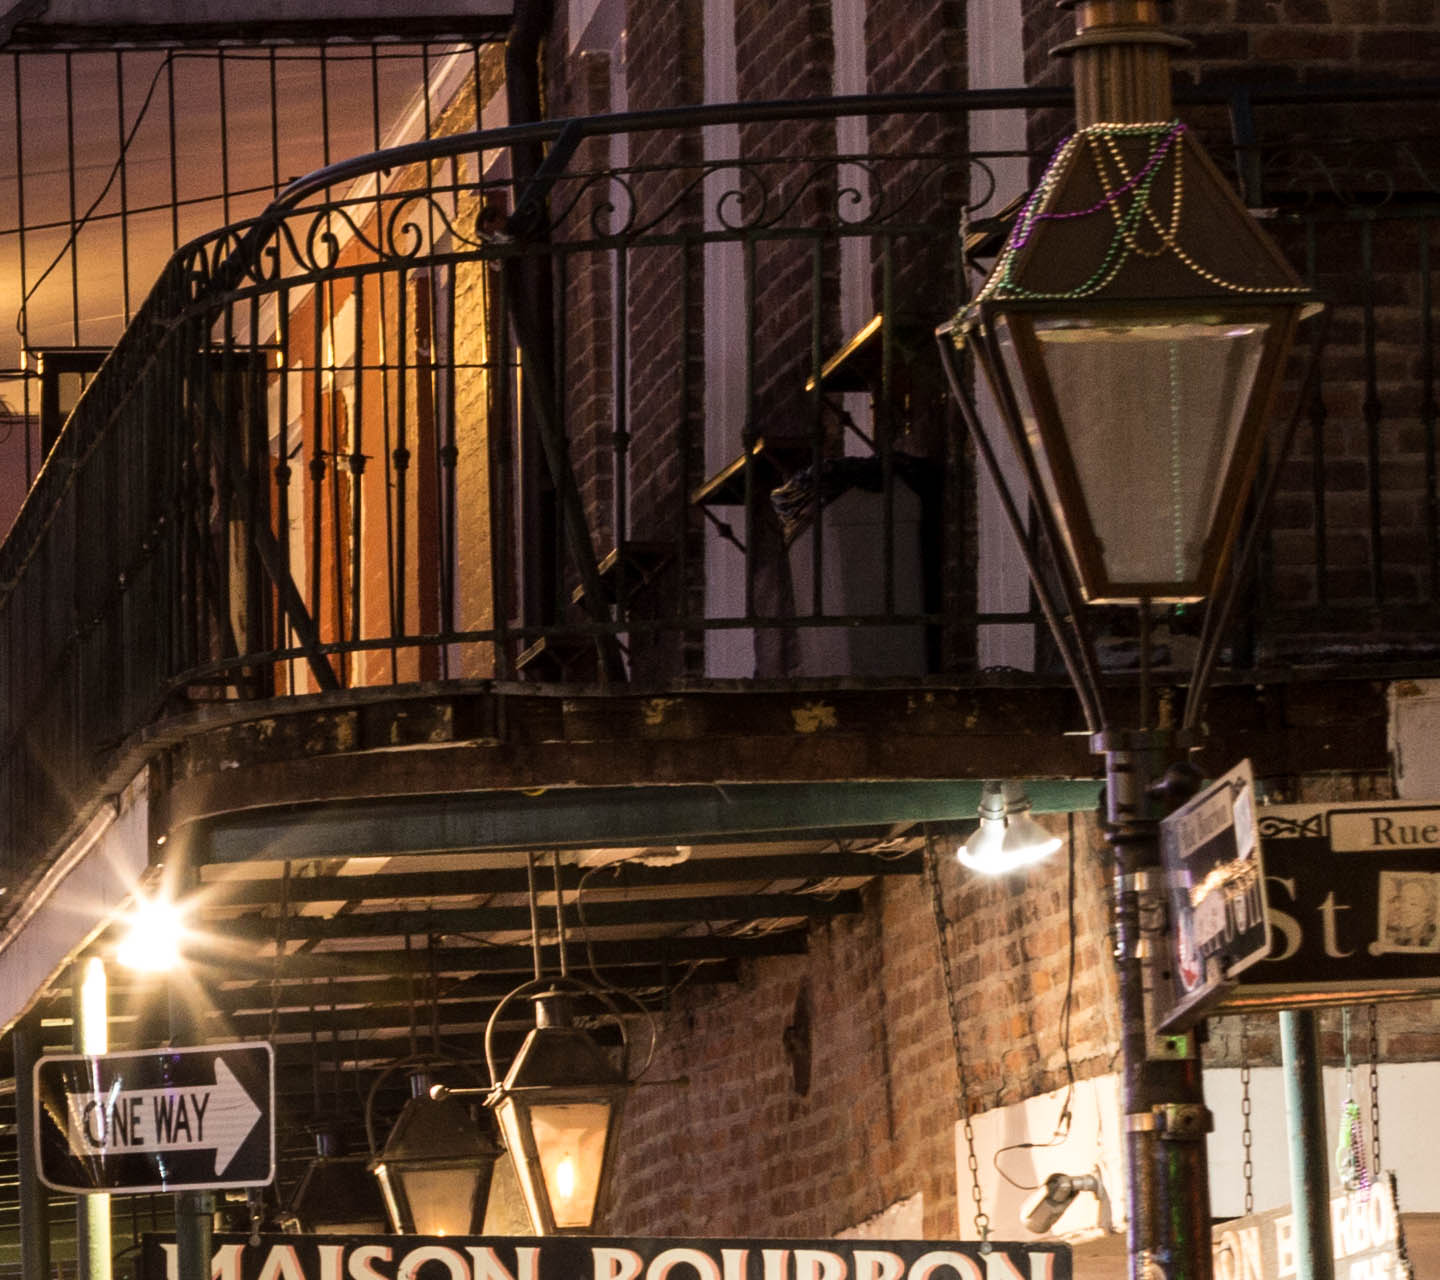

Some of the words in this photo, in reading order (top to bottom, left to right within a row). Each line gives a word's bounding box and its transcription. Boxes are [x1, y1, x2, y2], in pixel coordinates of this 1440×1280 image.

[1371, 815, 1439, 847] Rue
[82, 1097, 145, 1148] ONE
[154, 1093, 210, 1144] WAY
